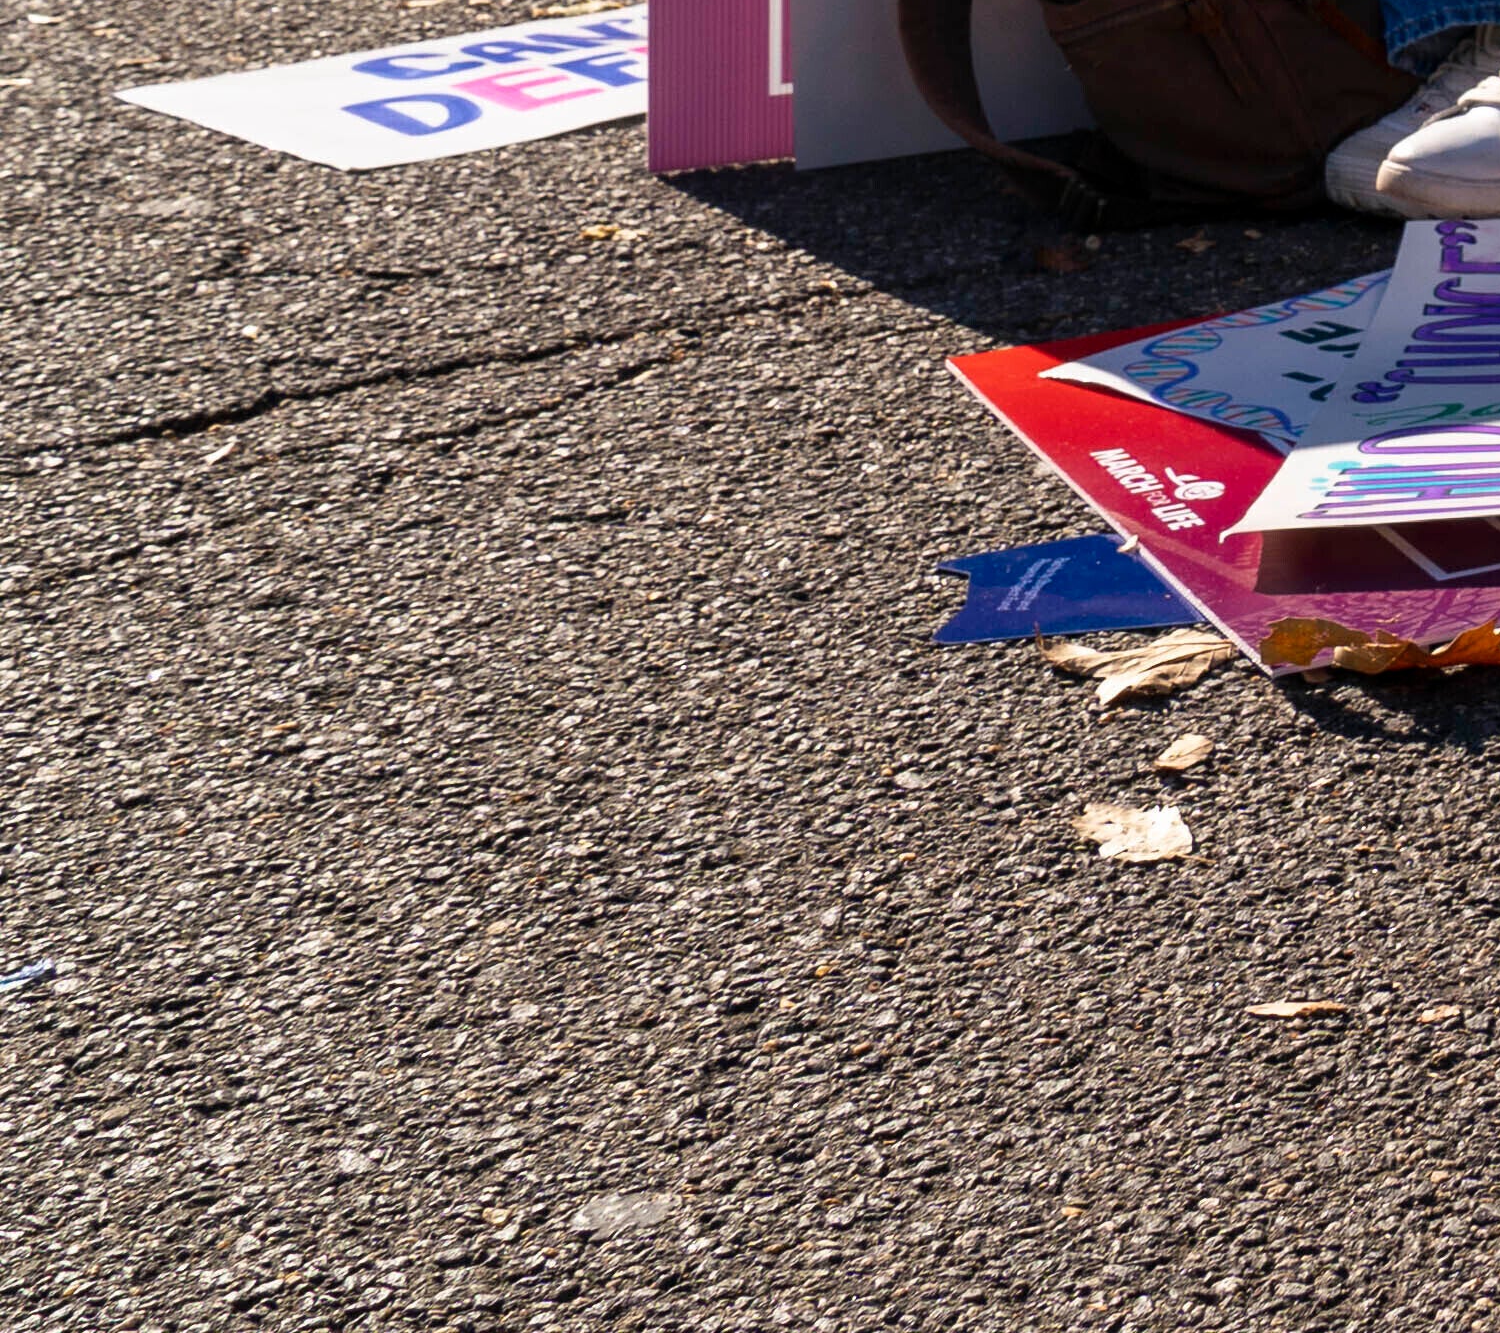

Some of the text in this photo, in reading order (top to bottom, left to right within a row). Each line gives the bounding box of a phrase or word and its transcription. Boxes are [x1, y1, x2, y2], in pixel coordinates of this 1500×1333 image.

[341, 46, 648, 137] DEF
[1089, 448, 1206, 531] MARCH FOR LIFE
